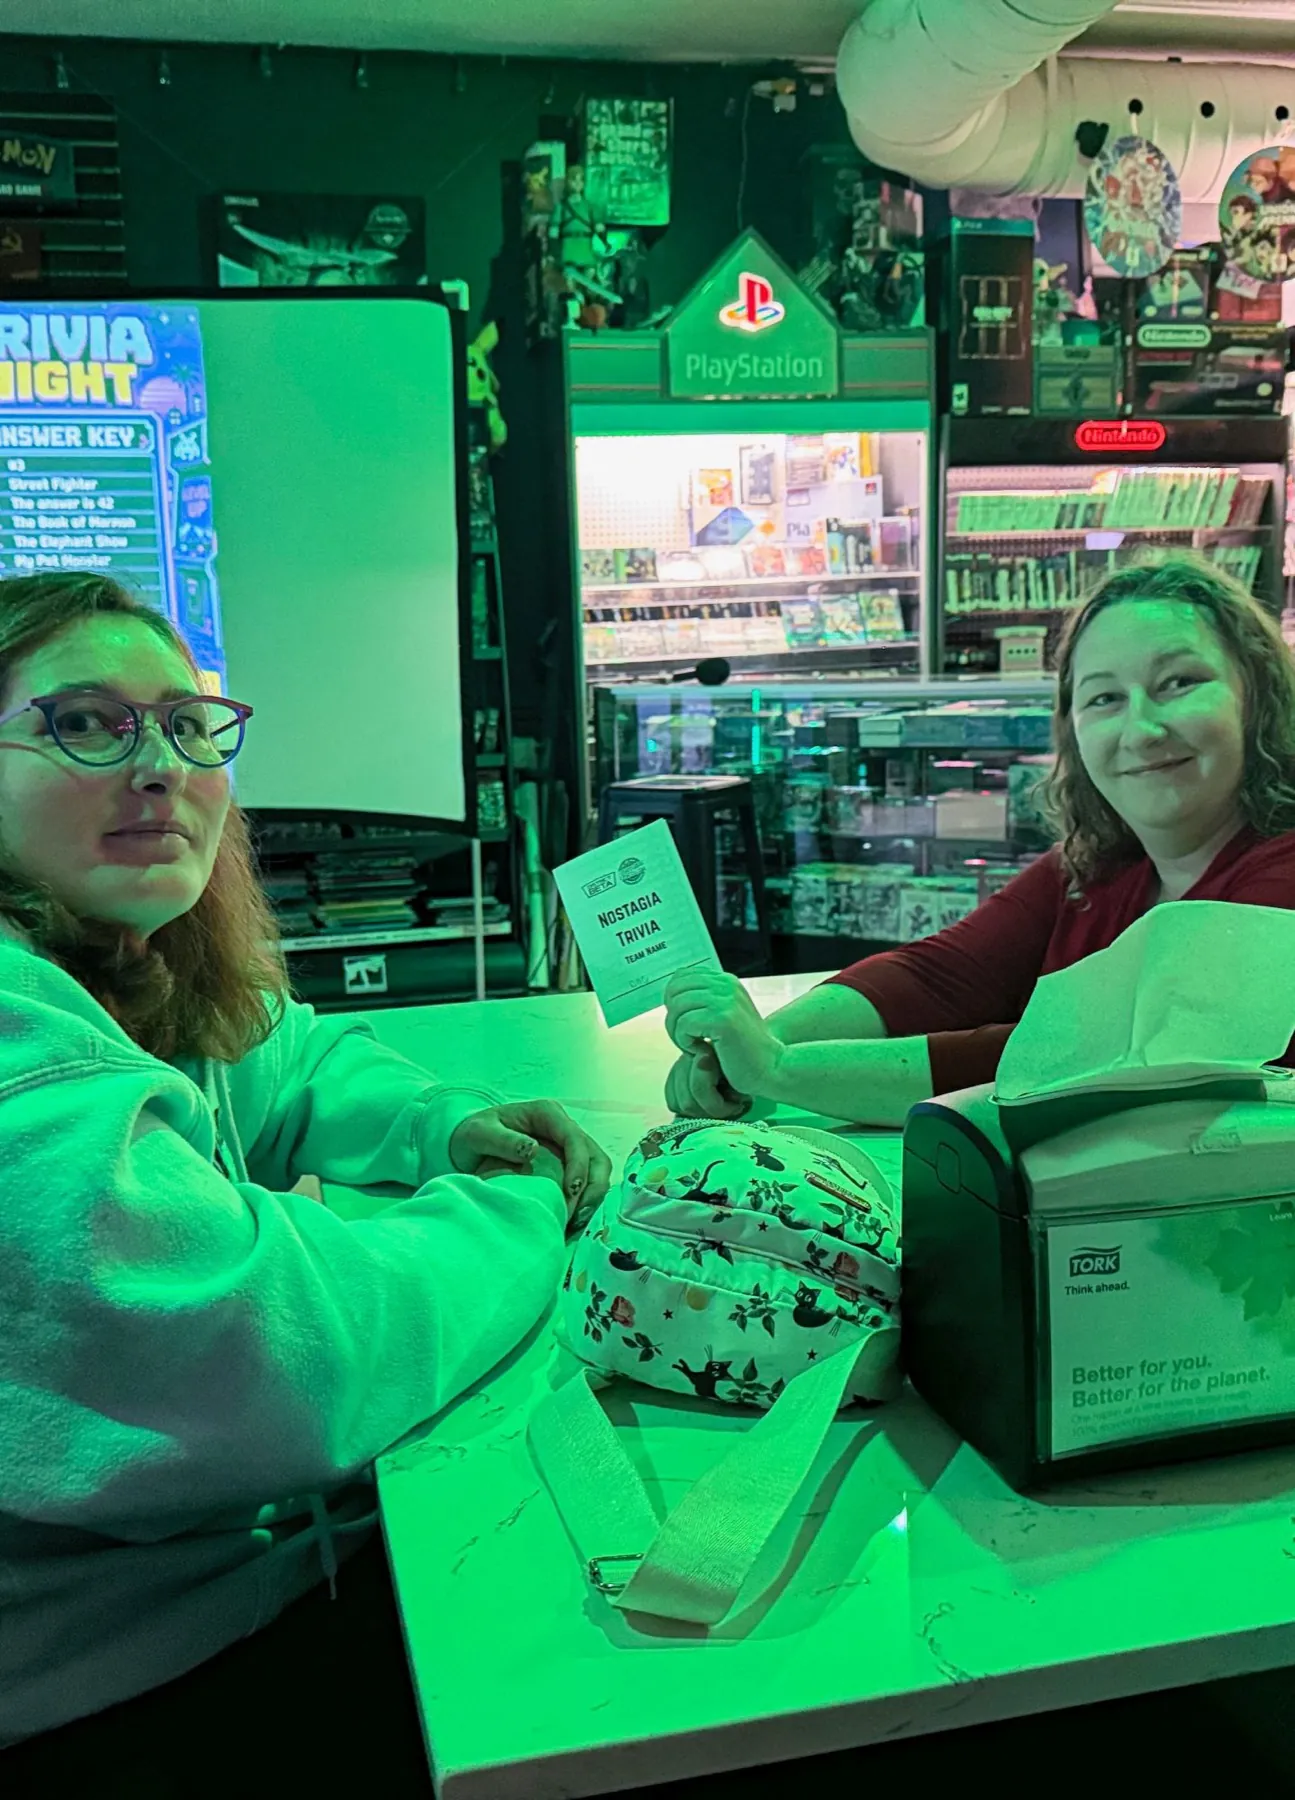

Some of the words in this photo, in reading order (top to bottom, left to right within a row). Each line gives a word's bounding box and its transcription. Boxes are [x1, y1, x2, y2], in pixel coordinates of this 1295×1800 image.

[0, 314, 154, 363] RIVIA
[686, 352, 824, 387] PlayStation
[0, 425, 82, 447] NSWER
[86, 425, 135, 447] KEY
[1084, 427, 1158, 443] Nintendo
[8, 477, 50, 490] Street
[51, 477, 99, 493] Fighter
[10, 496, 35, 510] The
[36, 498, 80, 510] answer
[81, 496, 96, 510] is
[97, 496, 115, 510] 42
[12, 515, 36, 528] The
[37, 515, 69, 528] Book
[70, 515, 87, 528] of
[13, 534, 38, 547] The
[95, 534, 128, 547] Show
[597, 891, 662, 928] NOSTAGIA
[615, 919, 661, 947] TRIVIA
[624, 950, 646, 964] TEAM
[645, 941, 668, 955] NAME
[1071, 1255, 1118, 1274] TORK
[1064, 1284, 1094, 1296] Think
[1095, 1280, 1131, 1293] ahead.
[1072, 1365, 1134, 1385] Better
[1140, 1359, 1168, 1377] for
[1172, 1354, 1213, 1375] you.
[1072, 1387, 1133, 1408] Better
[1138, 1382, 1165, 1398] for
[1170, 1375, 1201, 1392] the
[1206, 1365, 1271, 1393] planet.
